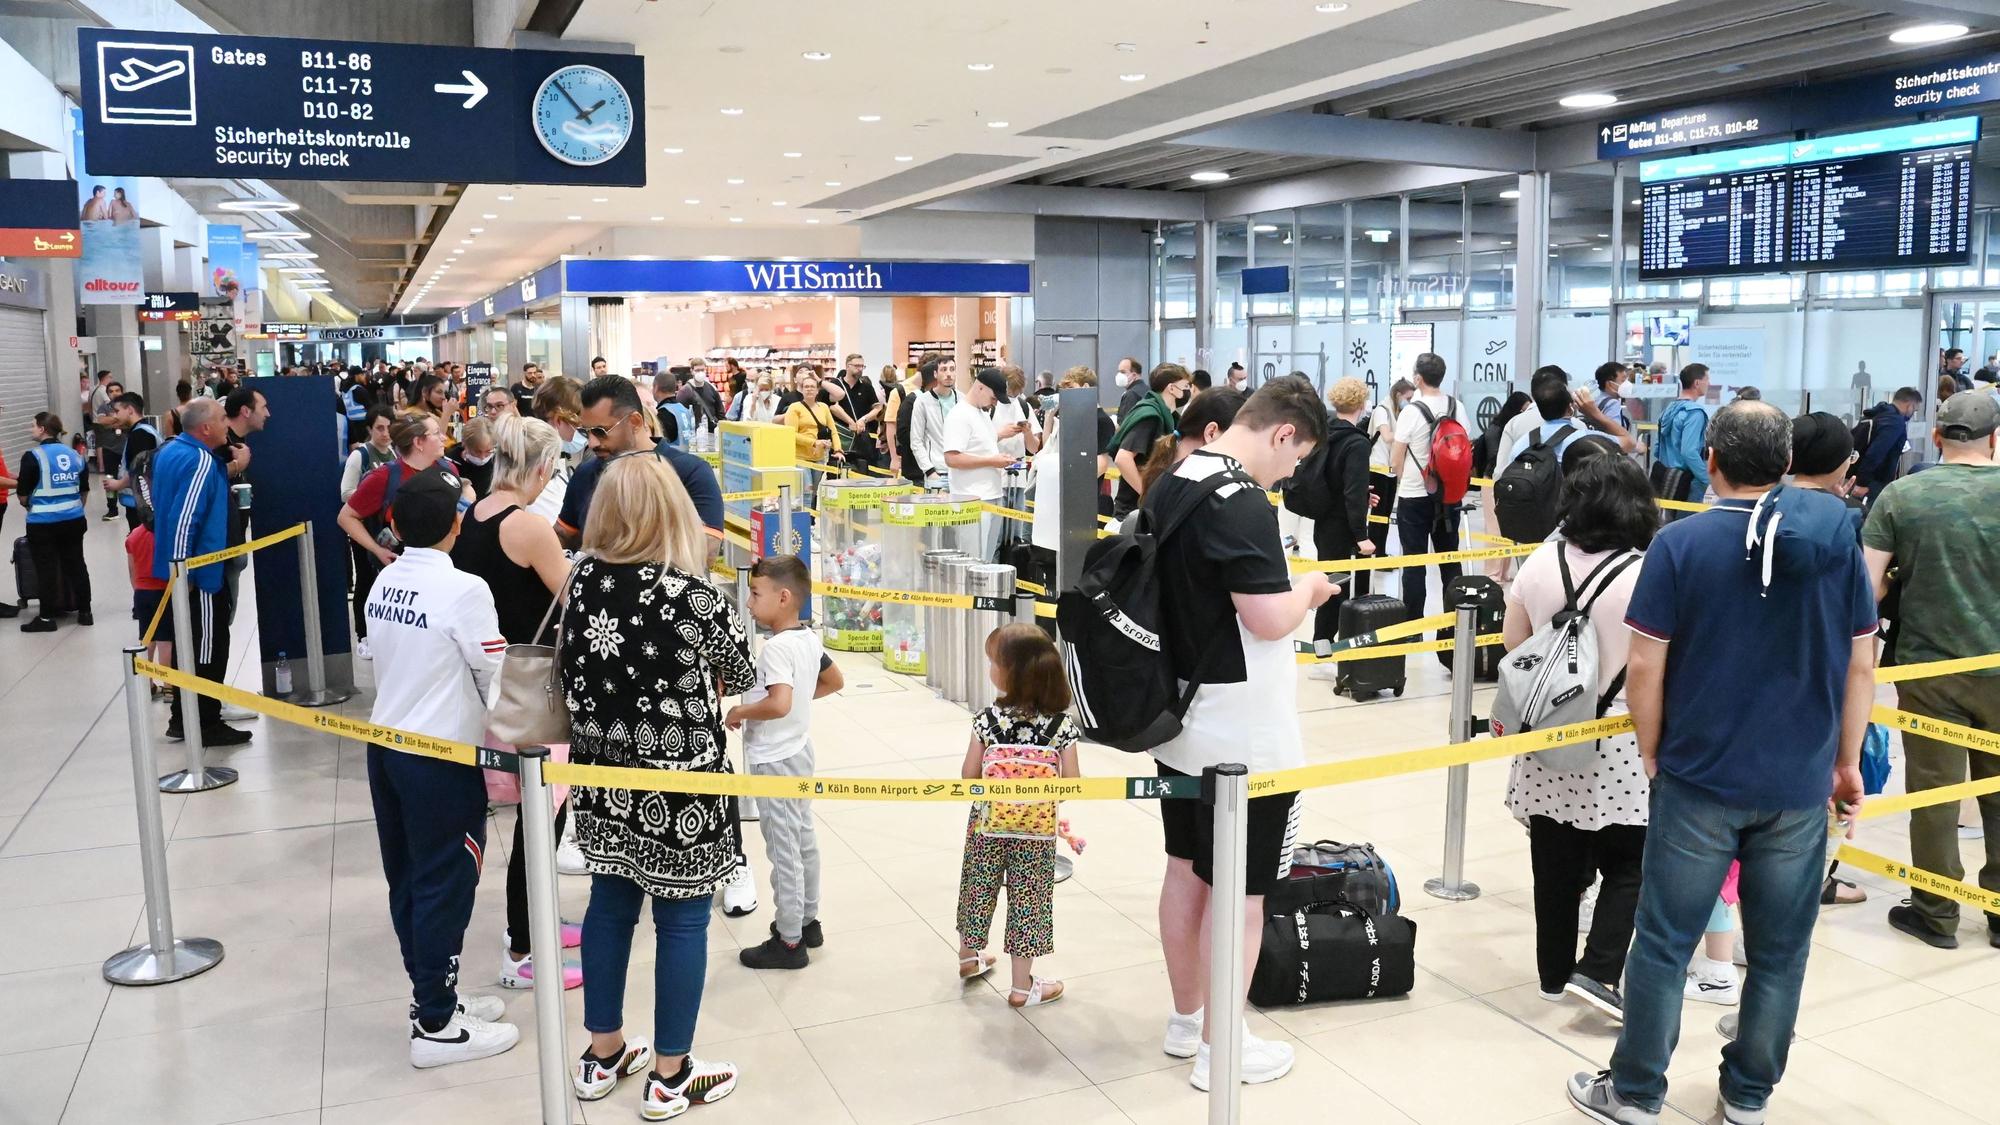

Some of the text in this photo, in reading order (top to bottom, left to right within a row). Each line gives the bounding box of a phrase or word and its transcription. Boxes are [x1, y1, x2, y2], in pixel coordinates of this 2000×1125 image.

[211, 46, 372, 71] Gates B11-86
[302, 76, 373, 96] C11-73
[1895, 62, 2000, 90] Sicherheitskontr
[1894, 83, 1980, 108] Security check
[303, 101, 374, 121] D10-82
[1629, 113, 1707, 134] Abflug Departures
[215, 126, 411, 149] Sicherheitskontrolle
[1628, 138, 1653, 149] Gates
[1725, 119, 1759, 134] D10-82
[216, 146, 350, 169] Security check
[84, 279, 140, 291] alltours
[745, 264, 883, 290] WHSmith
[318, 331, 344, 340] Marc
[346, 328, 384, 340] O'Polo
[467, 366, 489, 376] Eingang
[467, 376, 491, 385] Entrance
[1473, 362, 1507, 383] CGN
[924, 508, 949, 516] Donate
[382, 586, 419, 606] VISIT
[368, 603, 428, 629] RWANDA
[1569, 635, 1577, 664] #STYLE
[327, 718, 371, 736] Köln Bonn Airport
[1565, 721, 1620, 738] Köln Bonn Airport
[1921, 722, 2000, 749] Köln Bonn Airport
[404, 735, 453, 755] Köln Bonn Airport
[828, 783, 918, 796] Köln Bonn Airport
[989, 783, 1082, 796] Köln Bonn Airport
[1909, 872, 1987, 903] Köln Bonn Airport
